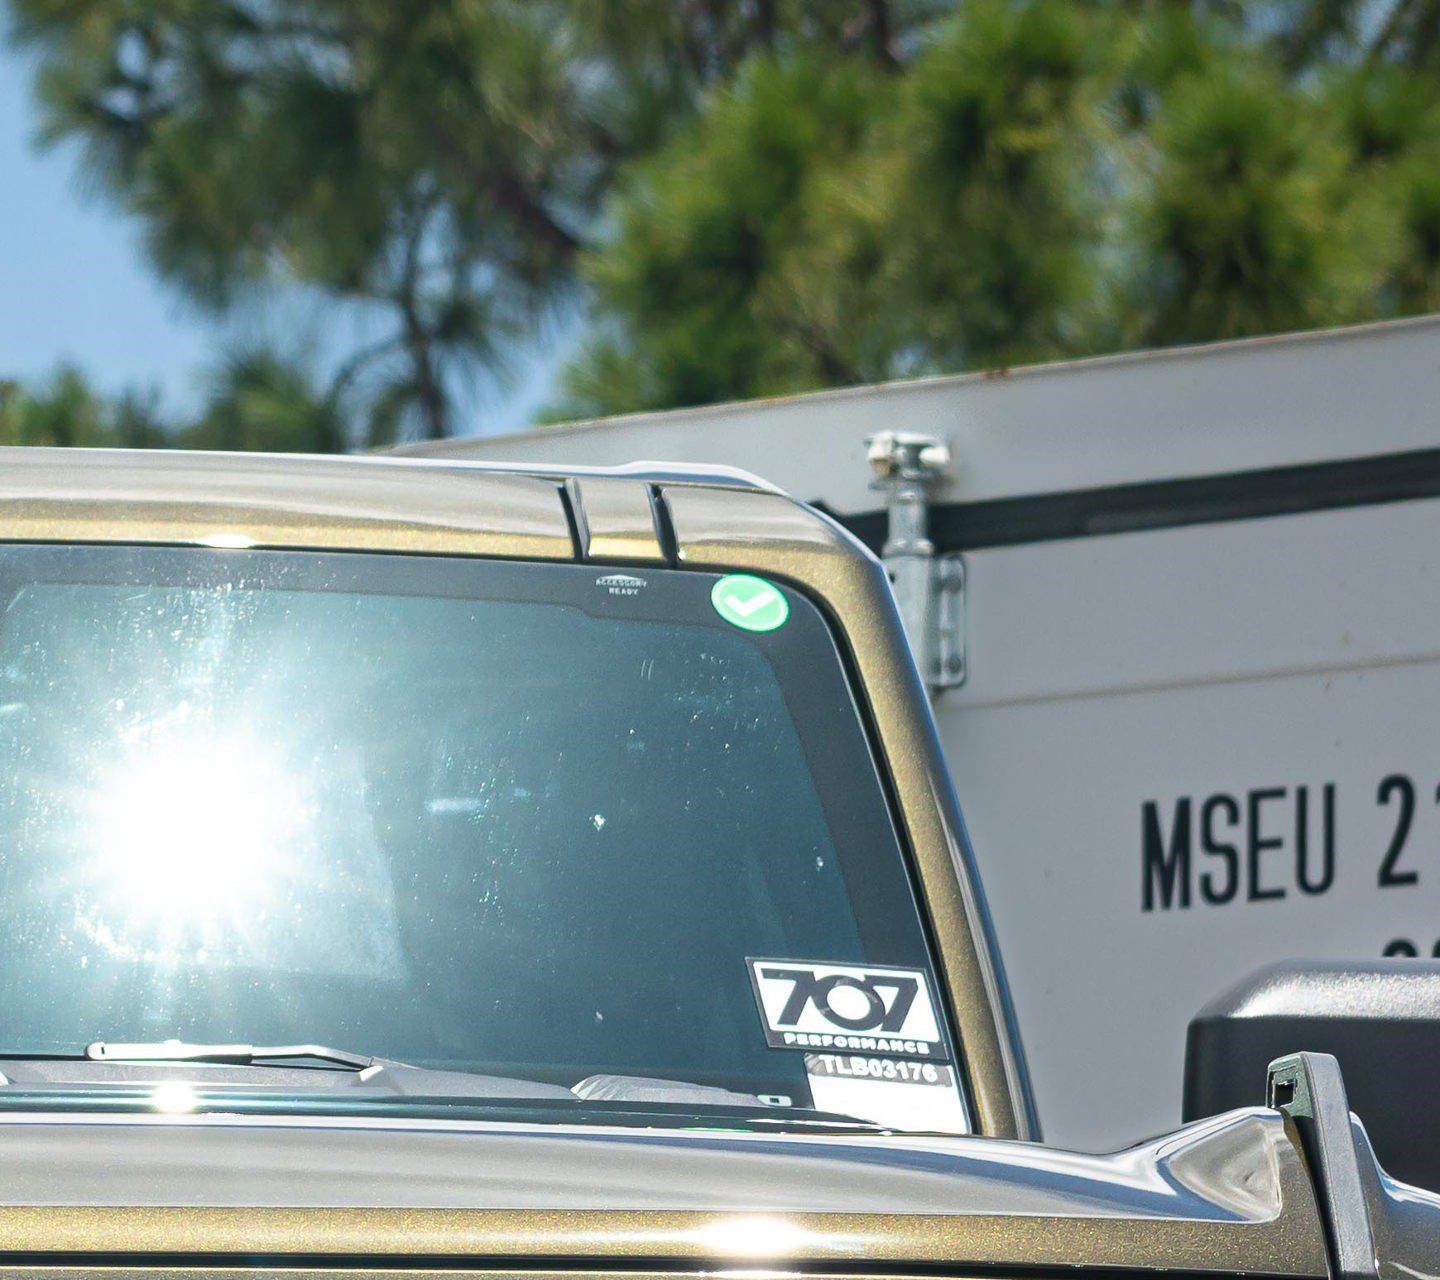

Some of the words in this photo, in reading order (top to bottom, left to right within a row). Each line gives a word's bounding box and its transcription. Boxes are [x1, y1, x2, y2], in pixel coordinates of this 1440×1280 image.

[608, 587, 639, 595] READY
[1141, 782, 1337, 912] MSEU
[762, 968, 919, 1032] 707
[784, 1033, 930, 1055] PERFORMANCE
[819, 1055, 938, 1082] TLB03176
